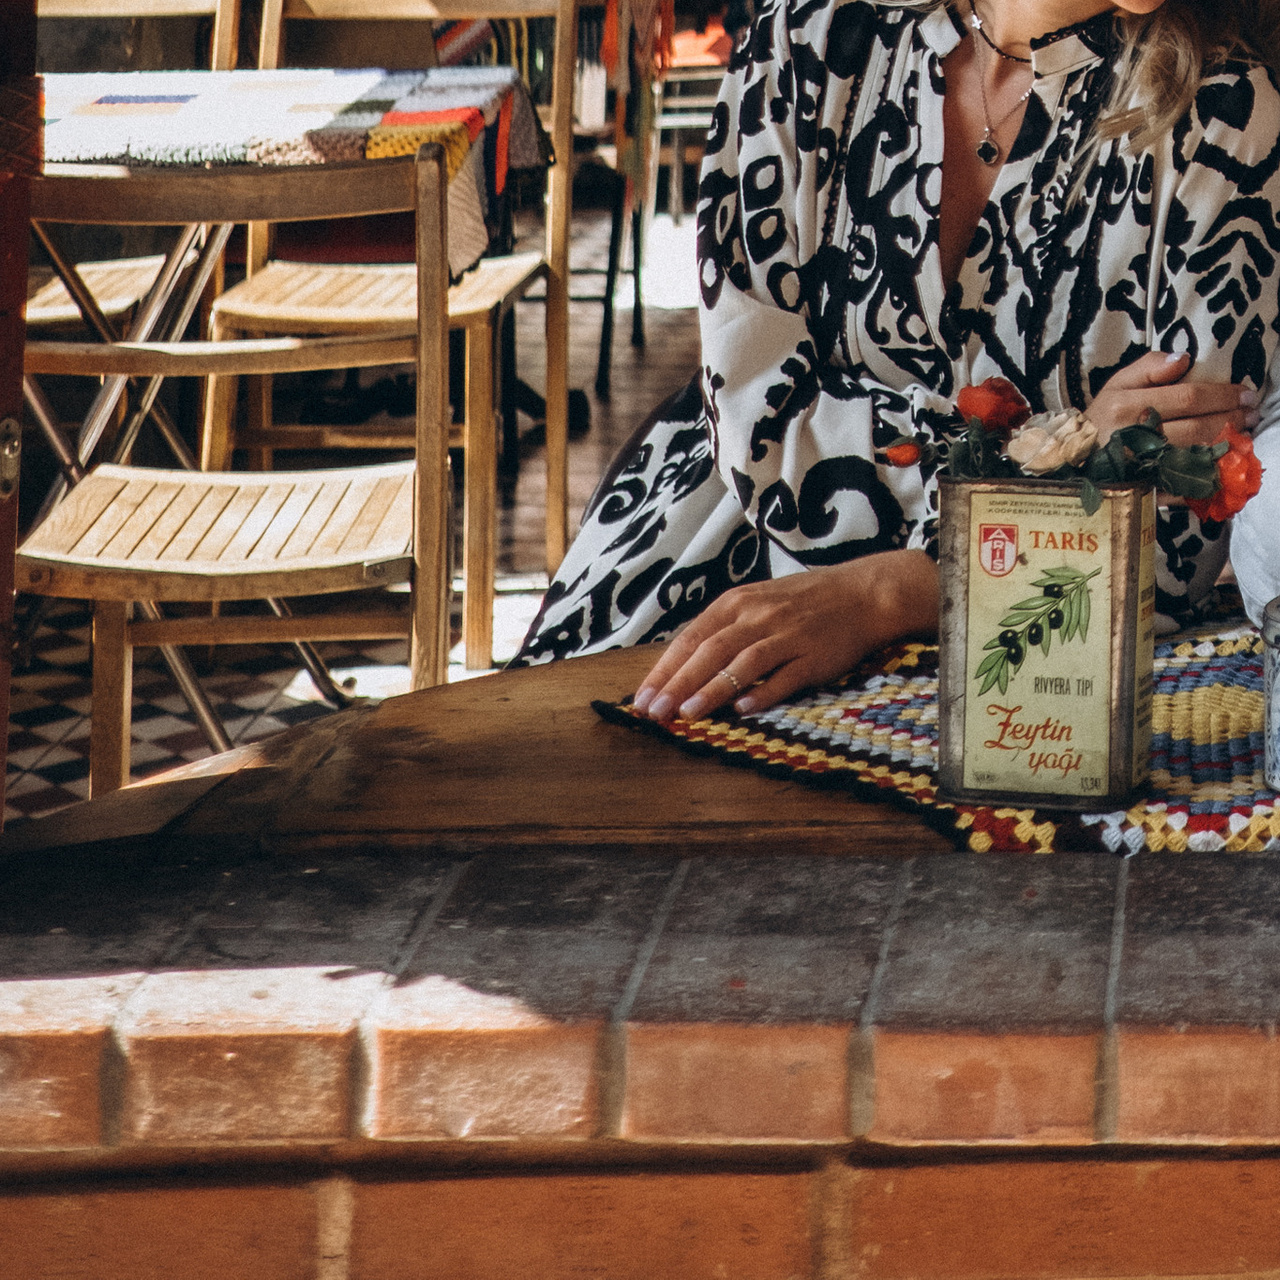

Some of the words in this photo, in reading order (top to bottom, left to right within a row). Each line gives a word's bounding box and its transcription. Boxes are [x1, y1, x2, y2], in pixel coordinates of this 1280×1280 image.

[1029, 528, 1099, 555] TARİŞ
[984, 704, 1072, 750] Zeytin
[1028, 747, 1083, 779] yağı
